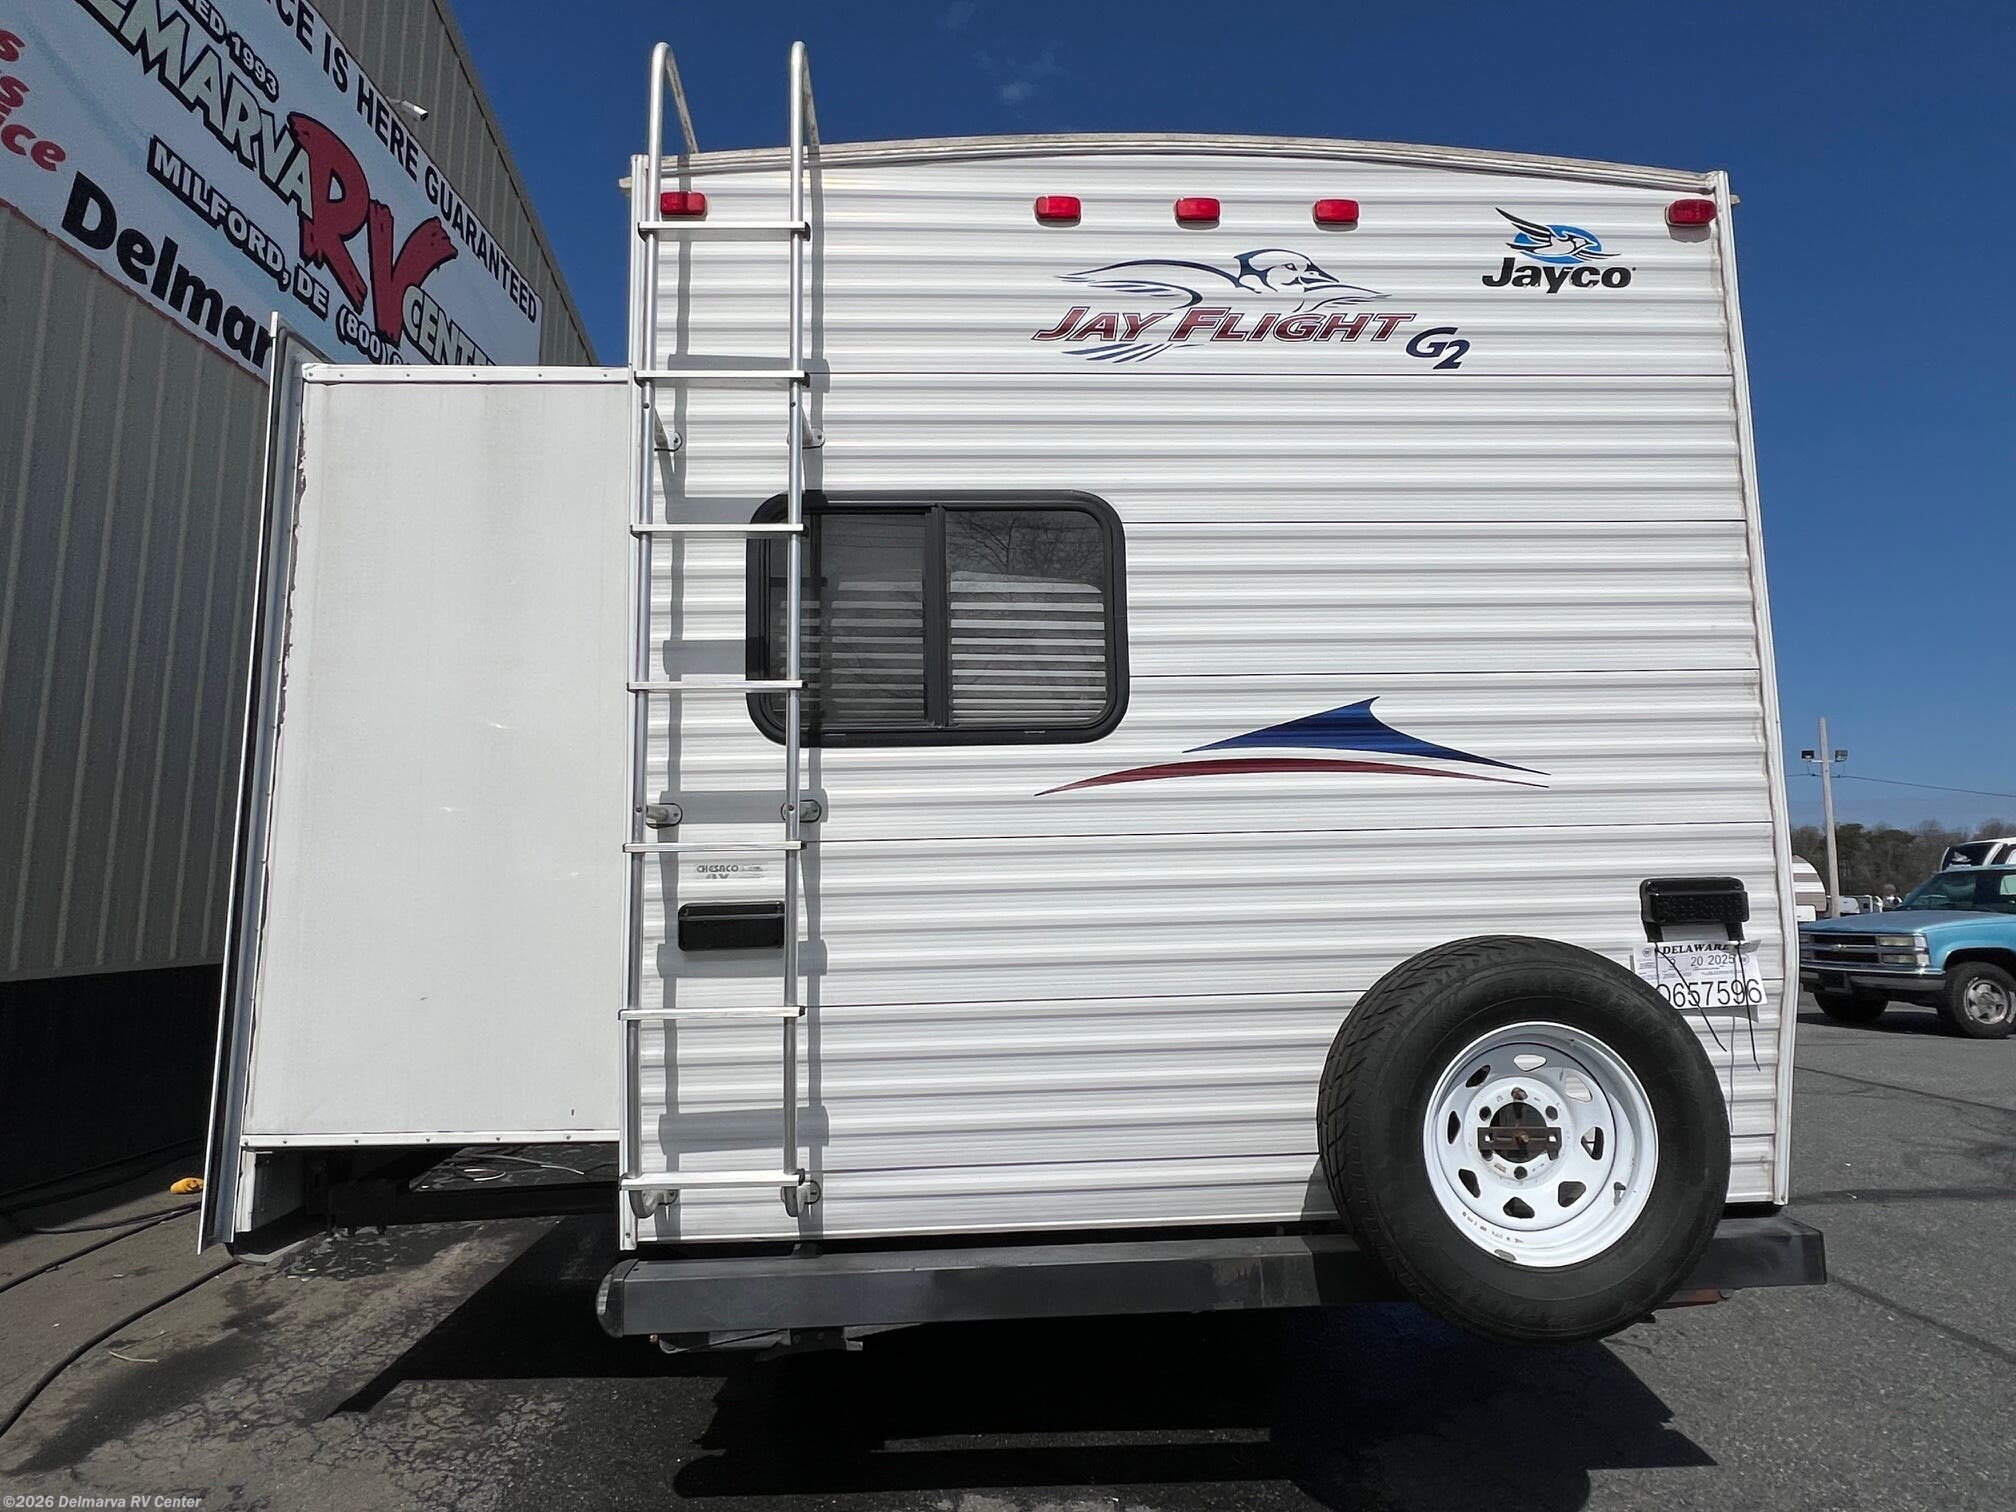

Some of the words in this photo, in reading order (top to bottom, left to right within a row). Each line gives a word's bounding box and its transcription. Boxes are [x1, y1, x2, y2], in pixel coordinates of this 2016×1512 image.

[178, 0, 227, 44] ED
[226, 31, 280, 103] 1993
[266, 0, 314, 54] CE
[322, 32, 349, 93] IS
[356, 74, 419, 183] HERE
[424, 165, 538, 324] GUARANTEED
[147, 135, 291, 292] MILFORD,
[292, 262, 330, 322] DE
[287, 112, 459, 346] RV
[1481, 256, 1633, 294] Jayco
[1030, 306, 1172, 342] JAY
[1167, 307, 1418, 343] FLIGHT
[1405, 326, 1471, 370] G2
[1690, 956, 1704, 967] 20
[1708, 954, 1736, 965] 2025
